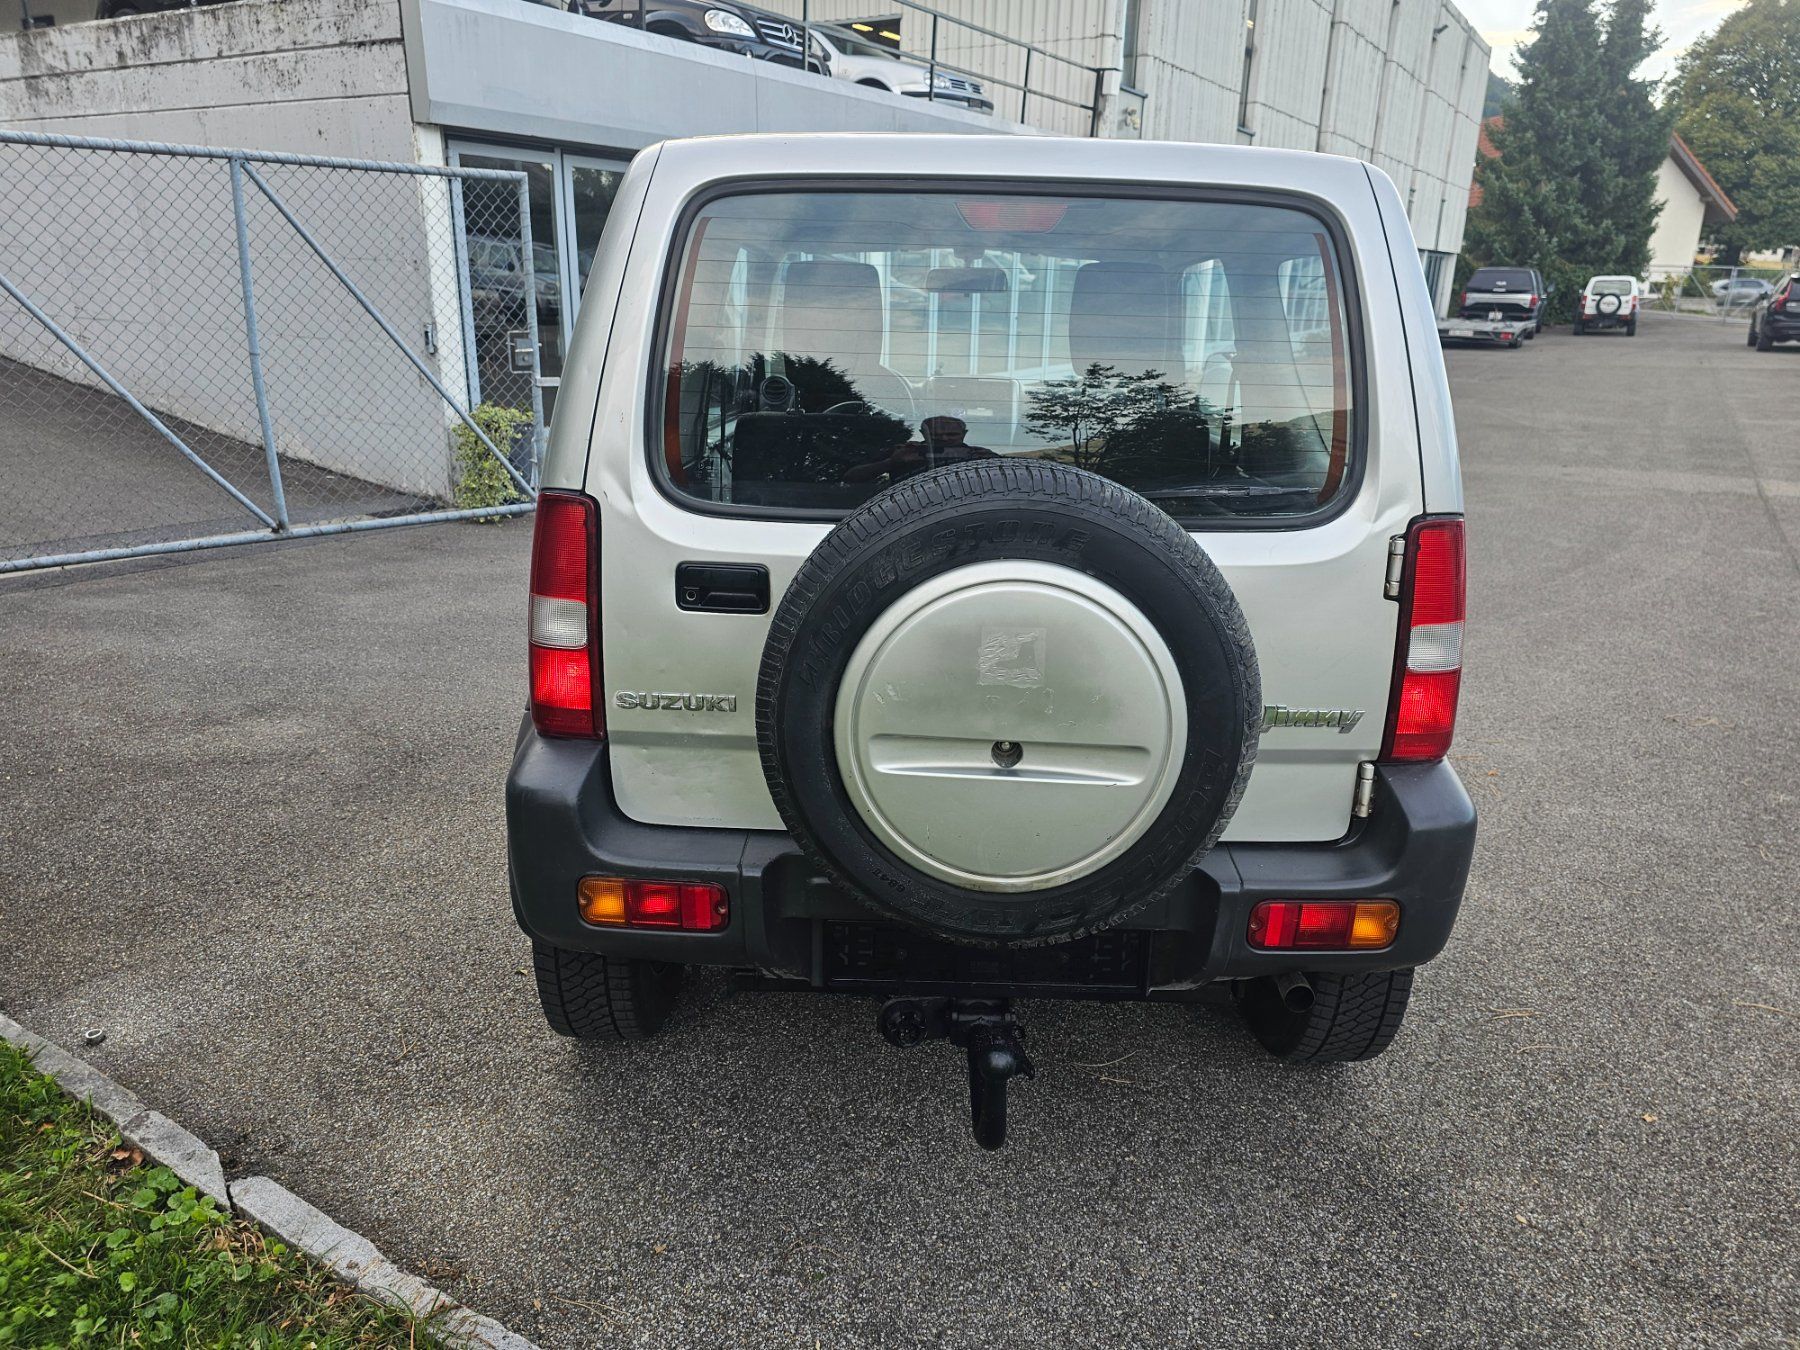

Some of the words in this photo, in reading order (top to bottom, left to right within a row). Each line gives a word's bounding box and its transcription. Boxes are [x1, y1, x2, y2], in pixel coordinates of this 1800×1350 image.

[798, 519, 1092, 692] BRIDGESTONE
[615, 690, 737, 713] SUZUKI
[1260, 705, 1366, 734] Jimny
